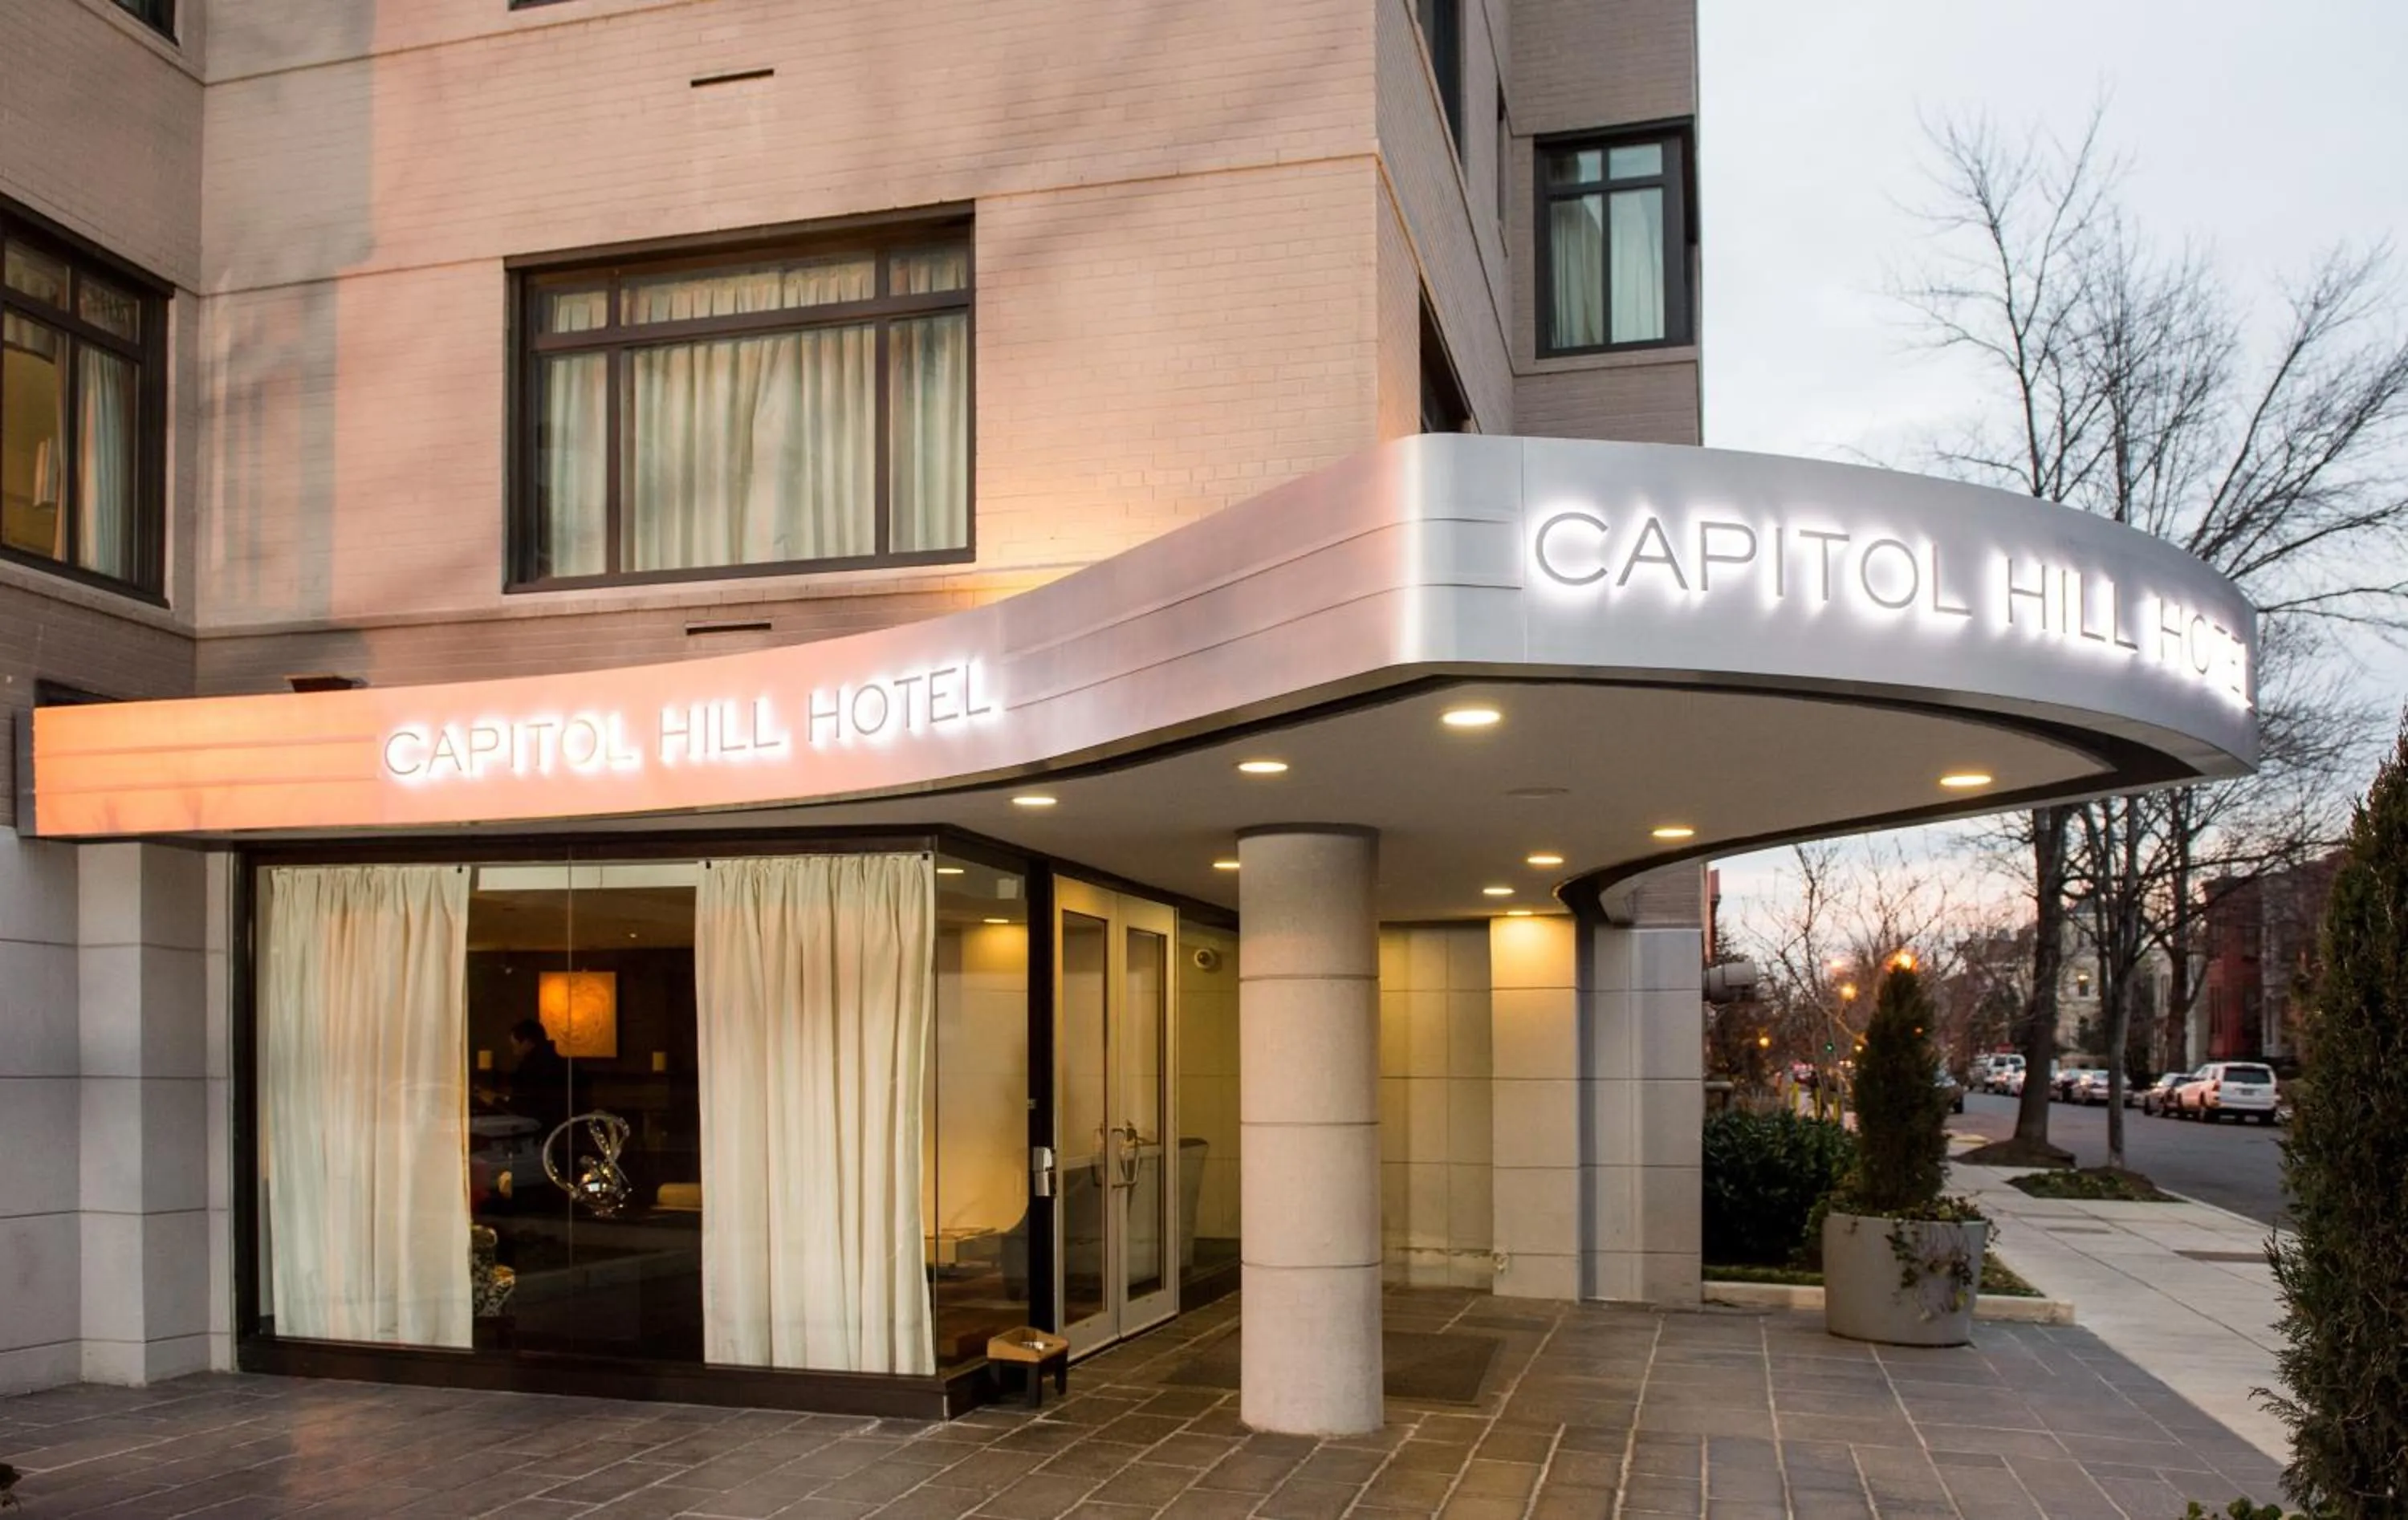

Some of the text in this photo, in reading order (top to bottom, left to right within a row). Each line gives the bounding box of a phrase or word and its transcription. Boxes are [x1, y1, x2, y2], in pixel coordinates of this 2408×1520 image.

[1534, 511, 1972, 618] CAPITOL
[2006, 556, 2138, 651] HILL
[384, 664, 992, 776] CAPITOL HILL HOTEL
